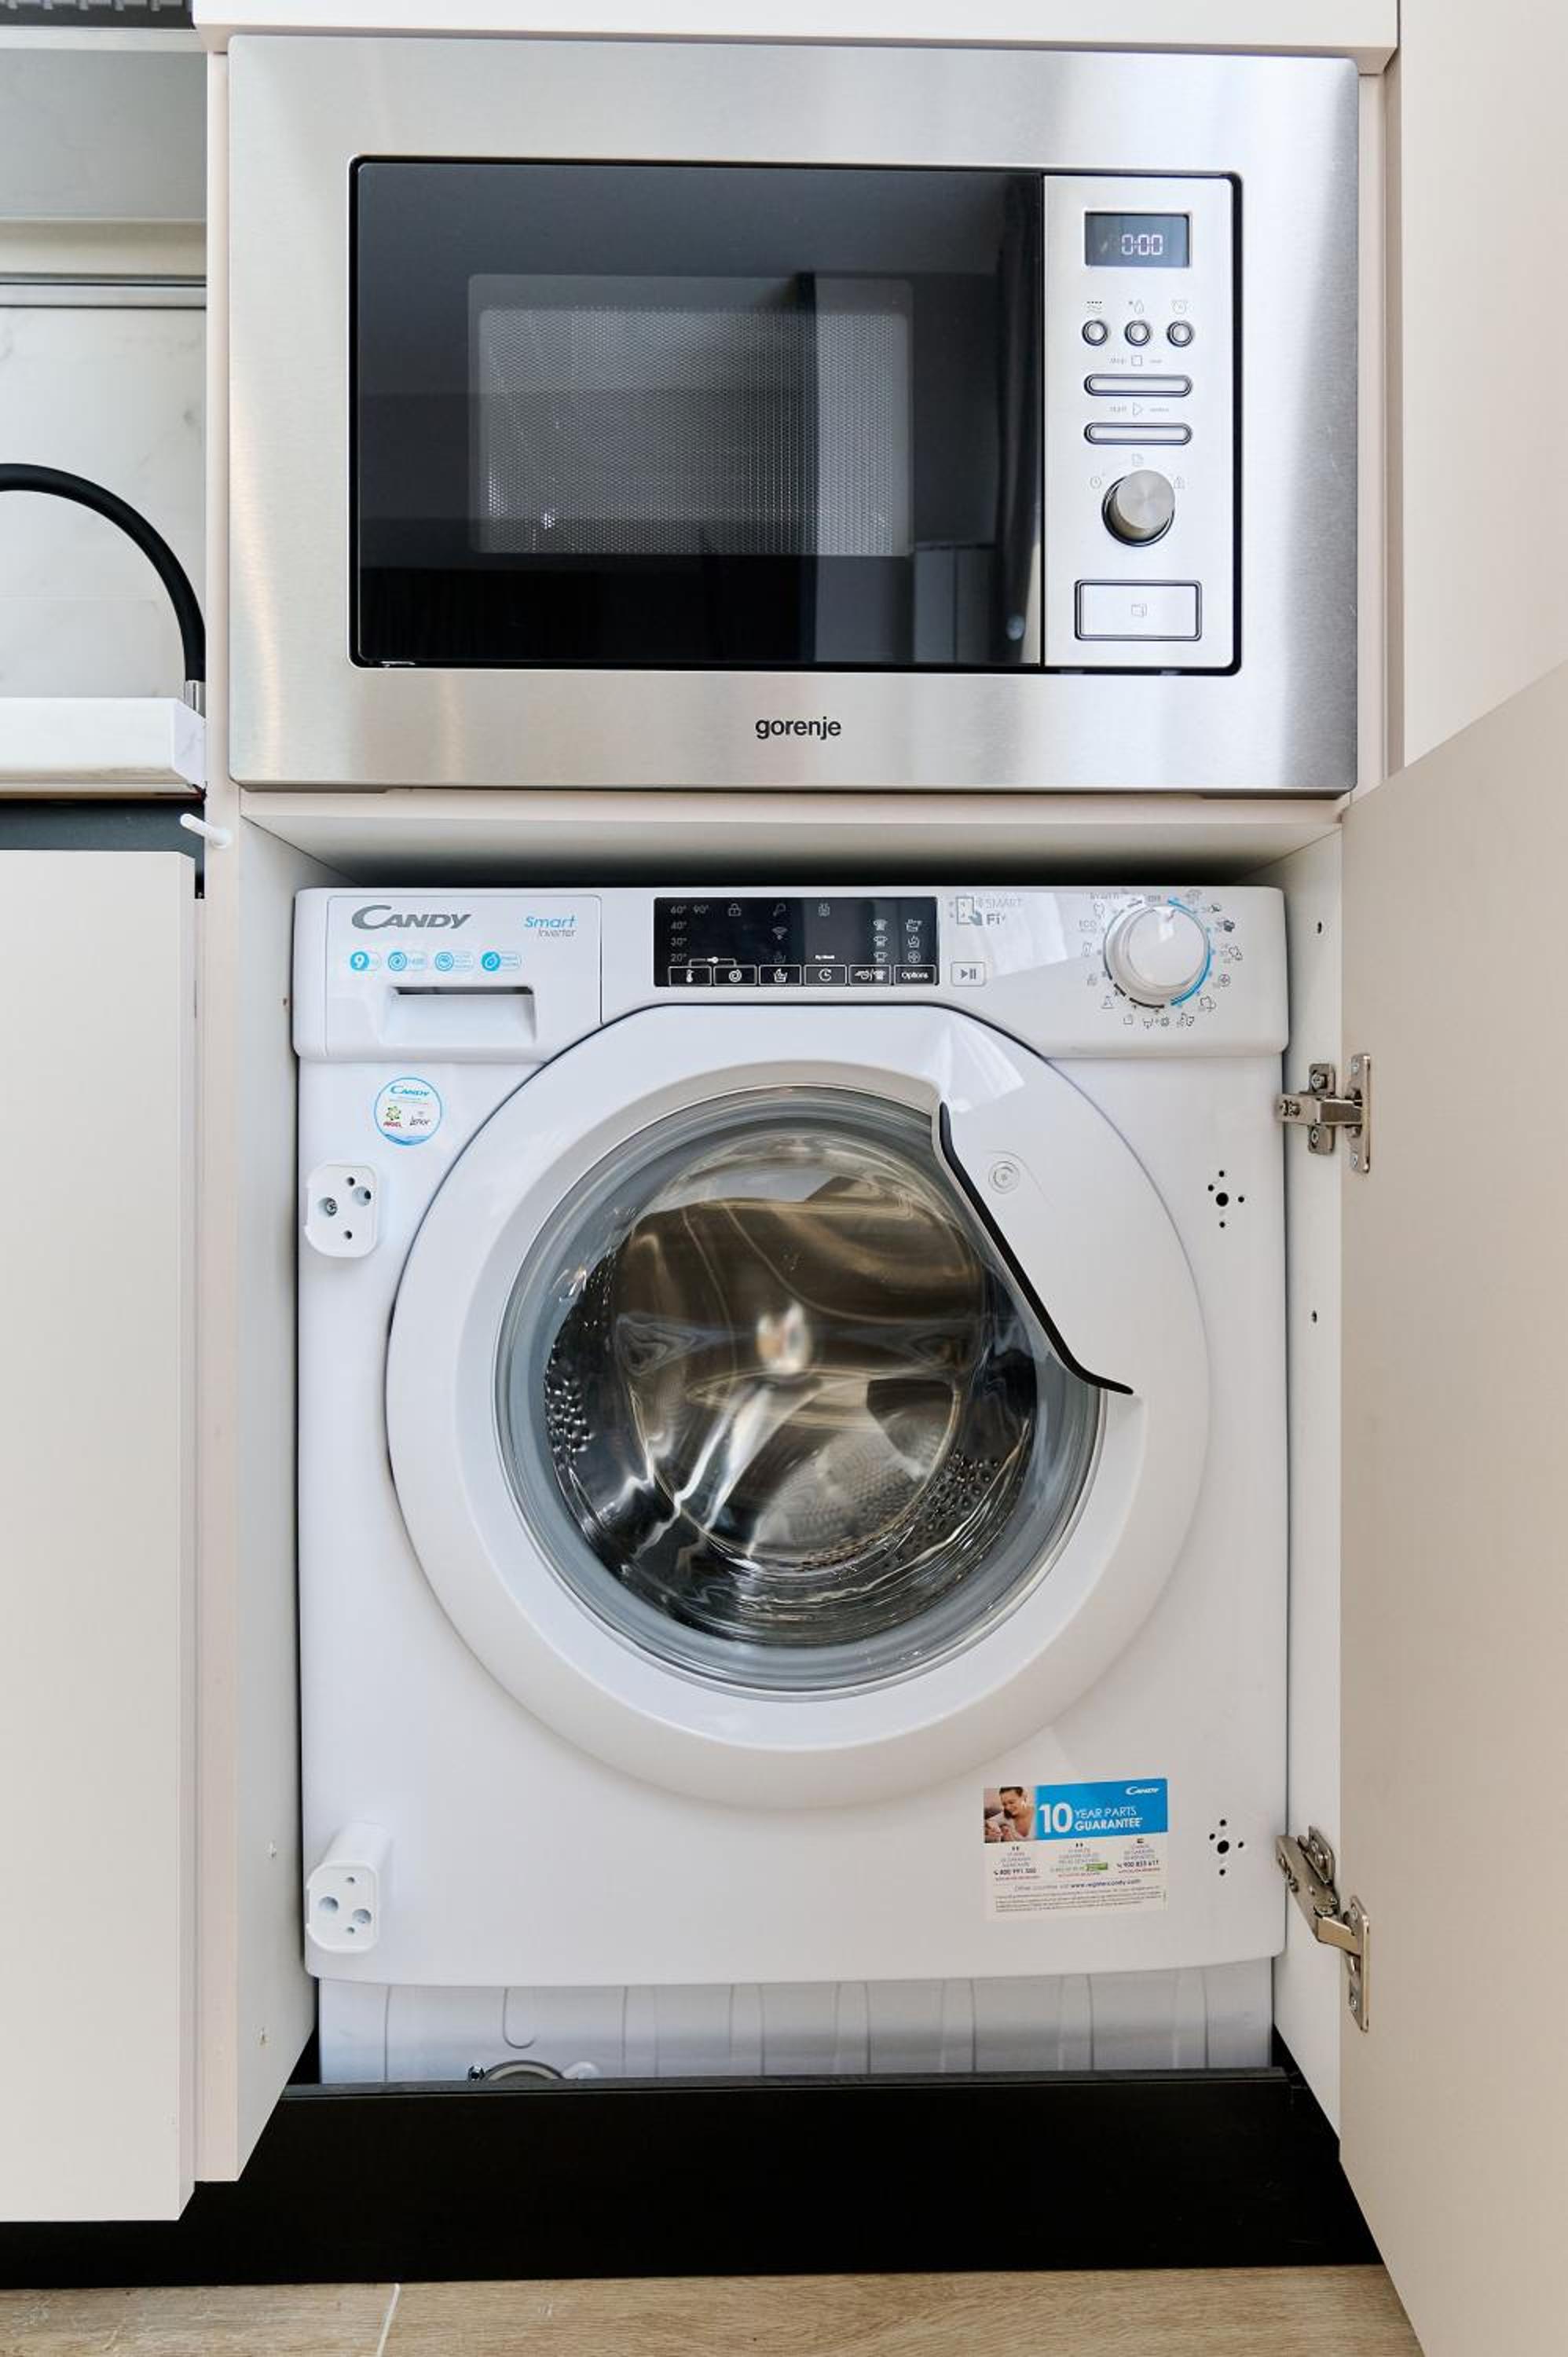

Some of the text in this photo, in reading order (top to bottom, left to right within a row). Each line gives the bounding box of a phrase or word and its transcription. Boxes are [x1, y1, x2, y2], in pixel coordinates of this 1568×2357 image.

[1122, 234, 1163, 255] 0:00
[755, 716, 841, 740] gorenje
[351, 904, 471, 930] CANDY
[524, 915, 576, 928] Smart
[355, 951, 368, 970] 9
[1039, 1802, 1137, 1833] 10 YEAR PARTS
